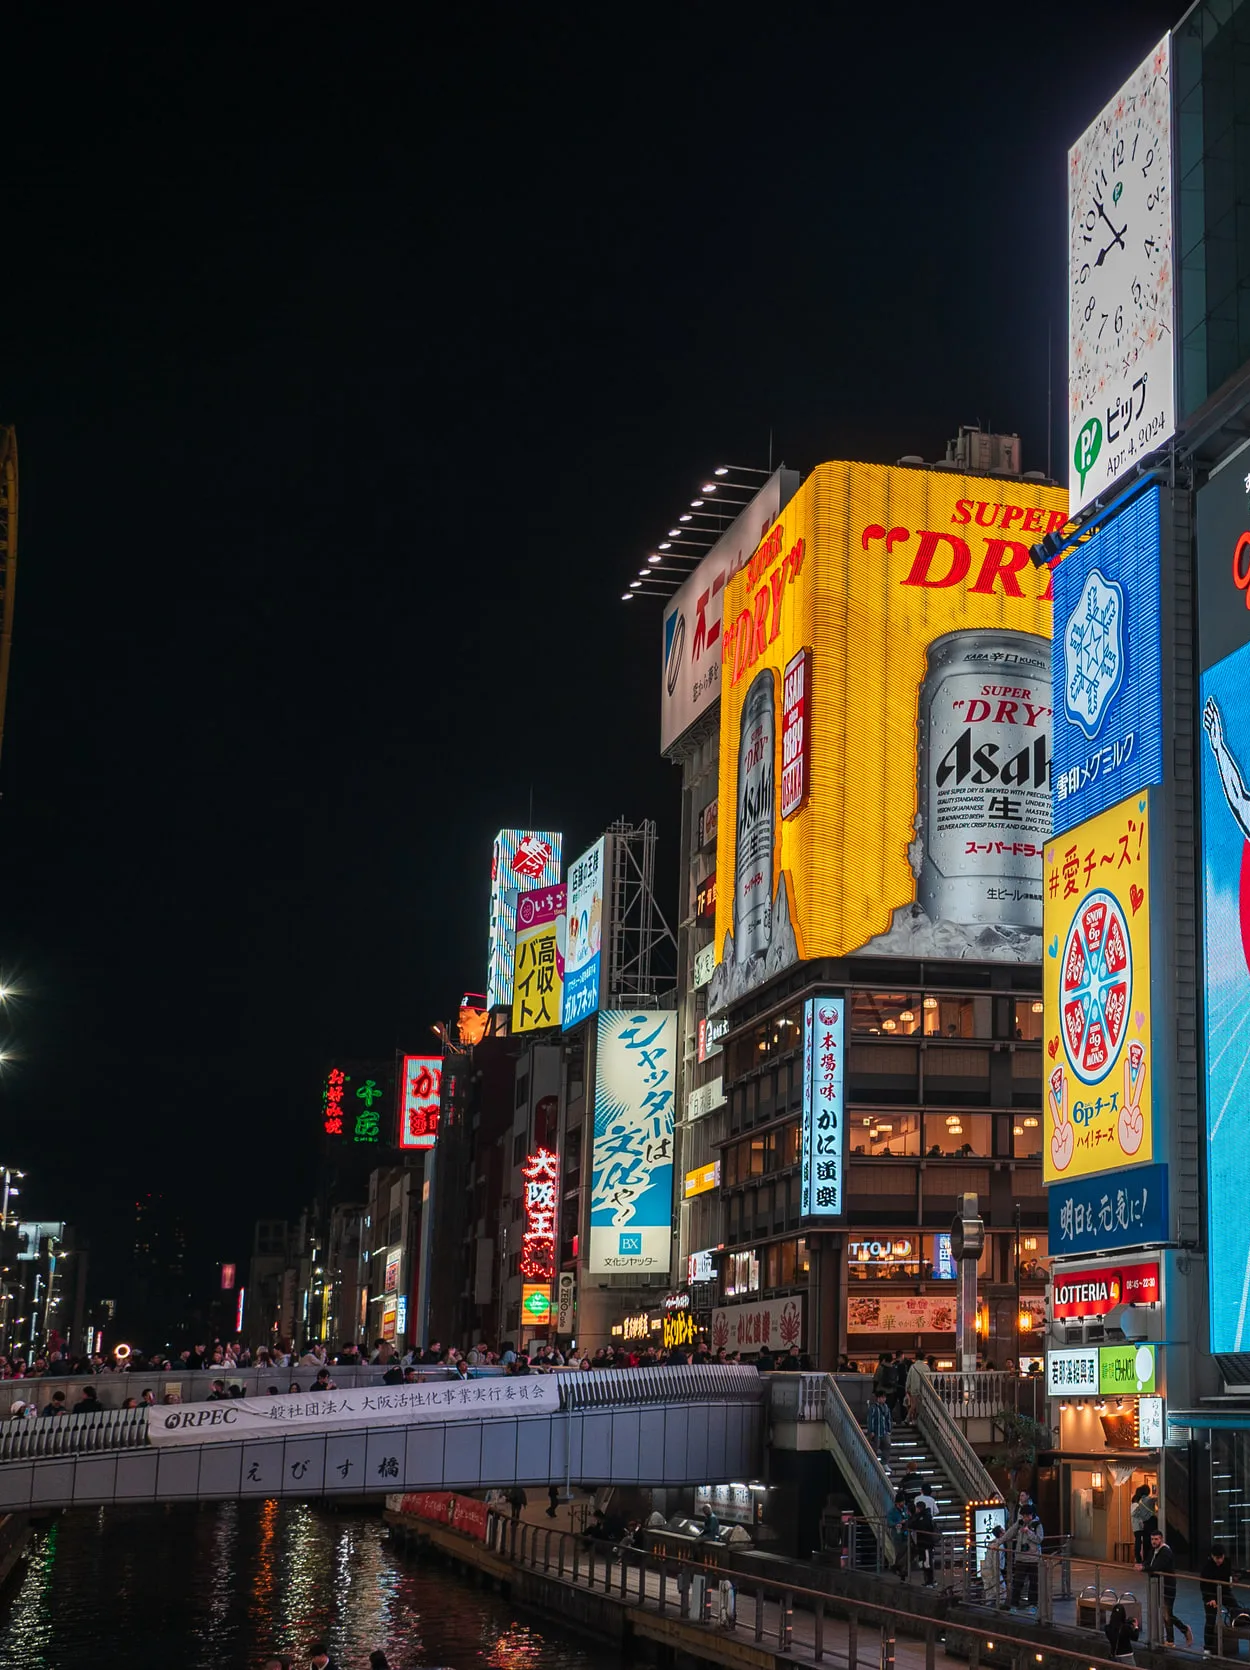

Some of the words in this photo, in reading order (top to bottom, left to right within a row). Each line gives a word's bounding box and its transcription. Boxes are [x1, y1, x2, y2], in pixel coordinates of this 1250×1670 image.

[1112, 139, 1124, 172] 12
[1132, 133, 1138, 161] 1
[1142, 149, 1154, 178] 2
[1144, 235, 1155, 259] 4
[1131, 275, 1141, 304] 5
[1085, 296, 1095, 322] 8
[1114, 305, 1123, 333] 6
[1098, 313, 1108, 340] 7
[1107, 372, 1148, 444] ピップ
[1107, 455, 1127, 477] Apr.
[1139, 411, 1165, 445] 2024
[951, 499, 1069, 535] SUPER
[746, 523, 784, 591] SUPER
[965, 653, 989, 661] KARA
[990, 652, 1018, 663] 辛口
[1020, 656, 1046, 669] KUCHI
[783, 664, 804, 717] ASAHI
[981, 685, 1032, 700] SUPER
[783, 716, 804, 768] 1889
[1058, 732, 1134, 802] 雪印メグミルク
[781, 761, 803, 812] OSAKA
[988, 797, 1022, 821] 生
[1026, 800, 1046, 808] UNDER
[1026, 808, 1049, 817] MASTER
[1086, 908, 1103, 925] SNOW
[1088, 927, 1100, 941] 6p
[518, 938, 538, 1028] バイト
[533, 936, 556, 1025] 高収入
[564, 979, 597, 1025] ガルフネット
[819, 1031, 836, 1101] 本場の味
[355, 1079, 383, 1136] 千房
[1073, 1091, 1119, 1126] 6pチーズ
[622, 1237, 639, 1249] BX
[604, 1256, 658, 1267] 文化シャッター
[560, 1288, 569, 1312] ZERO
[1055, 1282, 1108, 1305] LOTTERIA
[253, 1399, 355, 1420] 一般社団法人
[361, 1384, 546, 1411] 大阪活性化事業実行委員会
[247, 1456, 400, 1482] えびす橋
